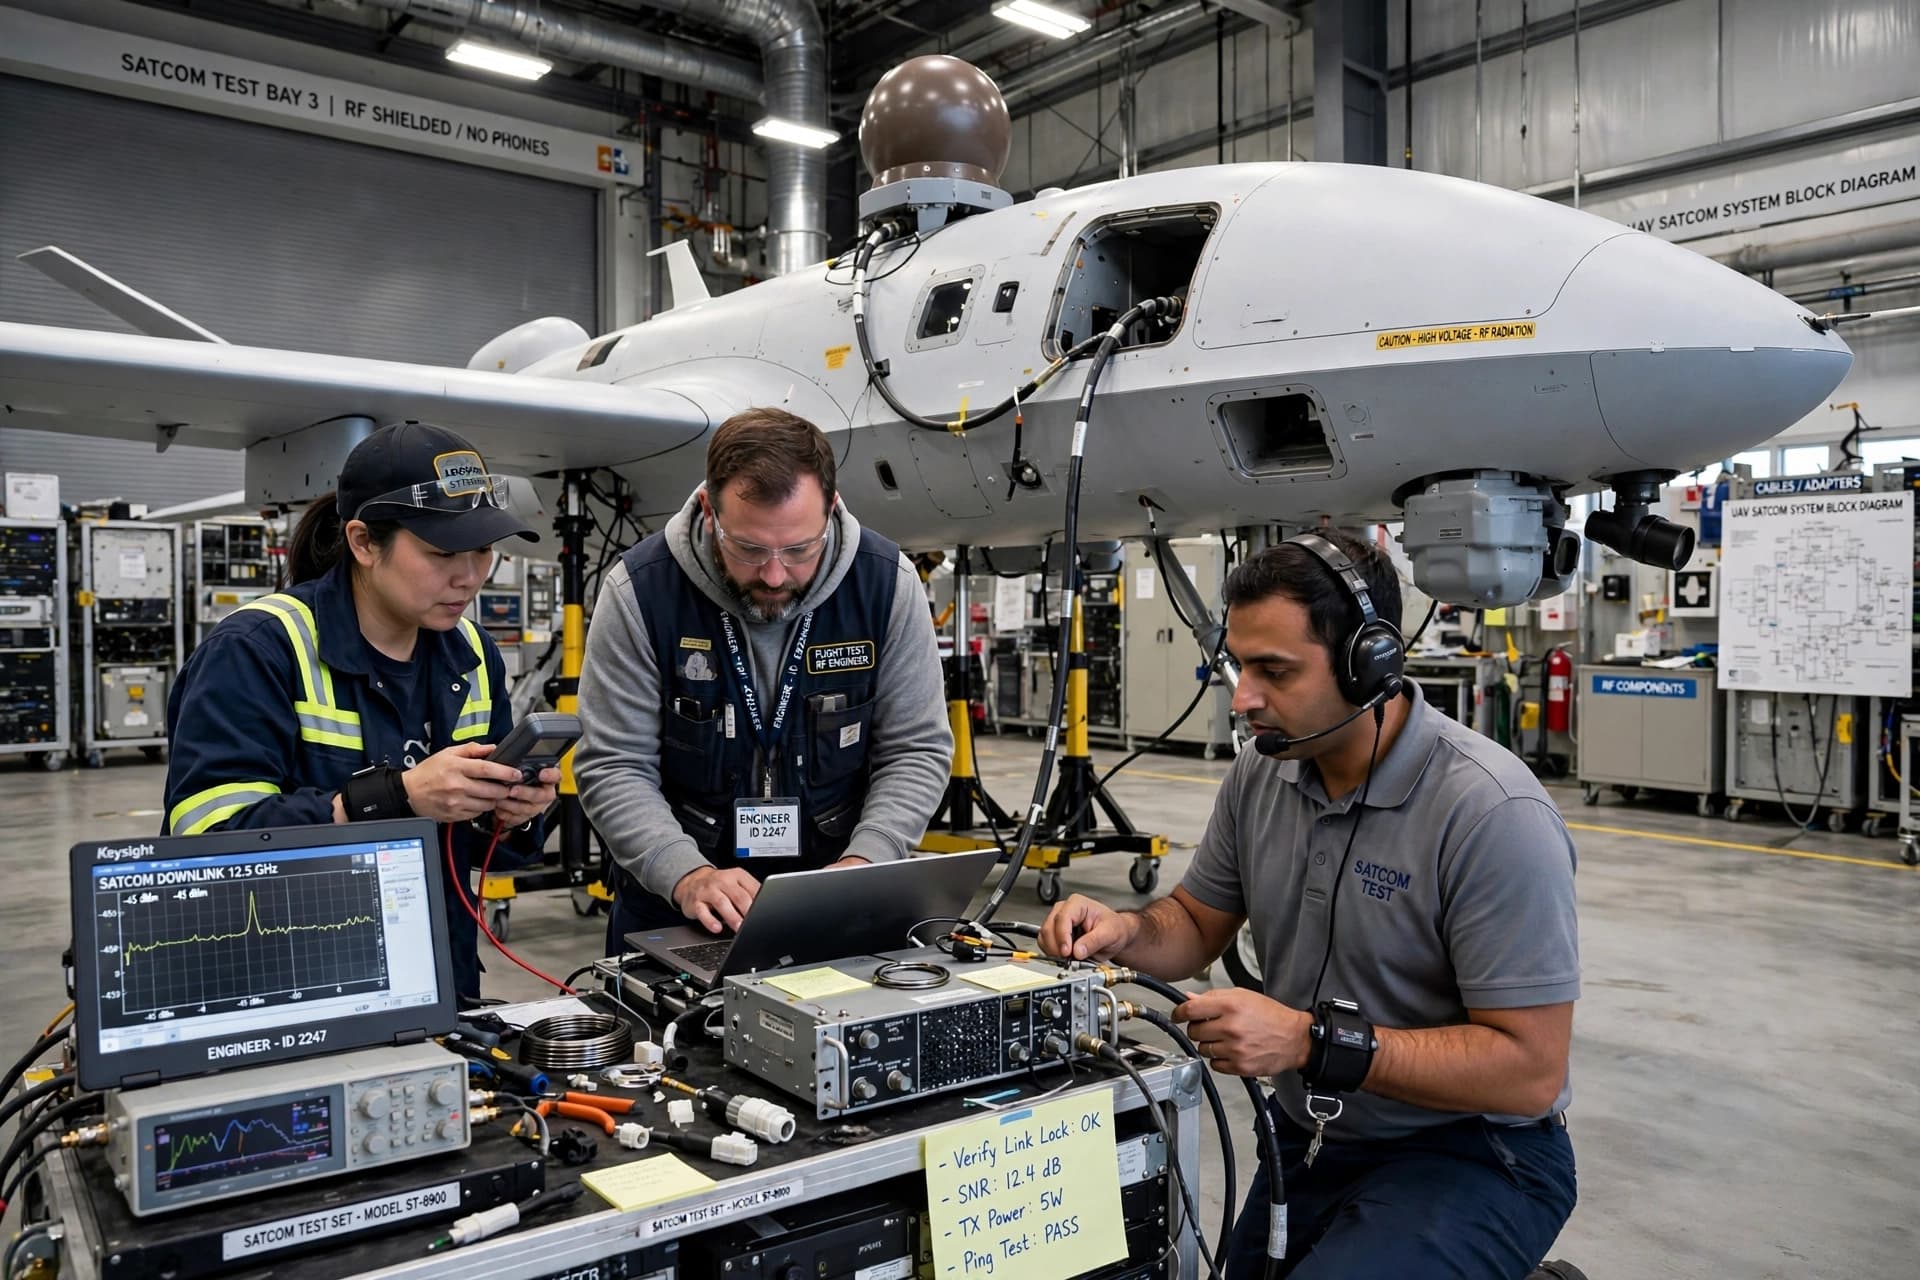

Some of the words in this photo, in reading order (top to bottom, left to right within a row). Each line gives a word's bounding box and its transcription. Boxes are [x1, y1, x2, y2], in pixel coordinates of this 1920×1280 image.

[121, 53, 206, 87] SATCOM
[212, 72, 260, 97] TEST
[266, 83, 302, 106] BAY
[308, 92, 319, 110] 3
[345, 100, 367, 118] RF
[372, 106, 451, 136] SHIELDED
[455, 123, 463, 139] /
[467, 125, 488, 143] NO
[492, 131, 550, 157] PHONES
[1659, 206, 1718, 230] SATCOM
[1723, 193, 1780, 218] SYSTEM
[1785, 182, 1836, 205] BLOCK
[1840, 165, 1916, 194] DIAGRAM
[1379, 334, 1411, 348] CAUTION
[1418, 332, 1437, 344] HIGH
[1438, 328, 1472, 342] VOLTAGE
[1479, 327, 1489, 337] RF
[1491, 324, 1533, 337] RADIATION
[1755, 481, 1794, 496] CABLES
[1804, 476, 1862, 491] ADAPTERS
[1731, 506, 1750, 518] UAV
[1752, 504, 1788, 518] SATCOM
[1791, 502, 1824, 515] SYSTEM
[1826, 500, 1857, 514] BLOCK
[1859, 498, 1903, 512] DIAGRAM
[815, 647, 844, 659] FLIGHT
[845, 645, 866, 656] TEST
[816, 660, 827, 670] RF
[828, 656, 870, 668] ENGINEER
[1601, 680, 1615, 691] RF
[1616, 680, 1685, 694] COMPONENTS
[740, 813, 791, 824] ENGINEER
[750, 827, 760, 838] ID
[762, 826, 787, 837] 2247
[97, 844, 155, 861] Keysight
[99, 873, 154, 890] SATCOM
[157, 867, 225, 886] DOWNLINK
[228, 864, 251, 879] 12.5
[254, 862, 279, 876] GHz
[1354, 860, 1411, 890] SATCOM
[1361, 879, 1395, 902] TEST
[207, 1038, 271, 1060] ENGINEER
[281, 1034, 295, 1048] ID
[298, 1030, 327, 1045] 2247
[953, 1140, 997, 1169] Verify
[1004, 1130, 1034, 1155] Link
[1040, 1119, 1075, 1145] Lock:
[1080, 1111, 1102, 1132] OK
[958, 1178, 998, 1205] SNR:
[1006, 1164, 1034, 1190] 12.4
[1042, 1156, 1062, 1178] dB
[243, 1224, 295, 1249] SATCOM
[299, 1216, 327, 1237] TEST
[331, 1211, 352, 1228] SET
[364, 1202, 403, 1221] MODEL
[406, 1190, 447, 1211] ST-8900
[652, 1213, 687, 1233] SATCOM
[958, 1215, 981, 1238] TX
[988, 1201, 1033, 1229] Power:
[1040, 1187, 1063, 1211] 5W
[964, 1250, 994, 1275] Ping
[1000, 1233, 1037, 1259] Test:
[1044, 1215, 1080, 1244] PASS
